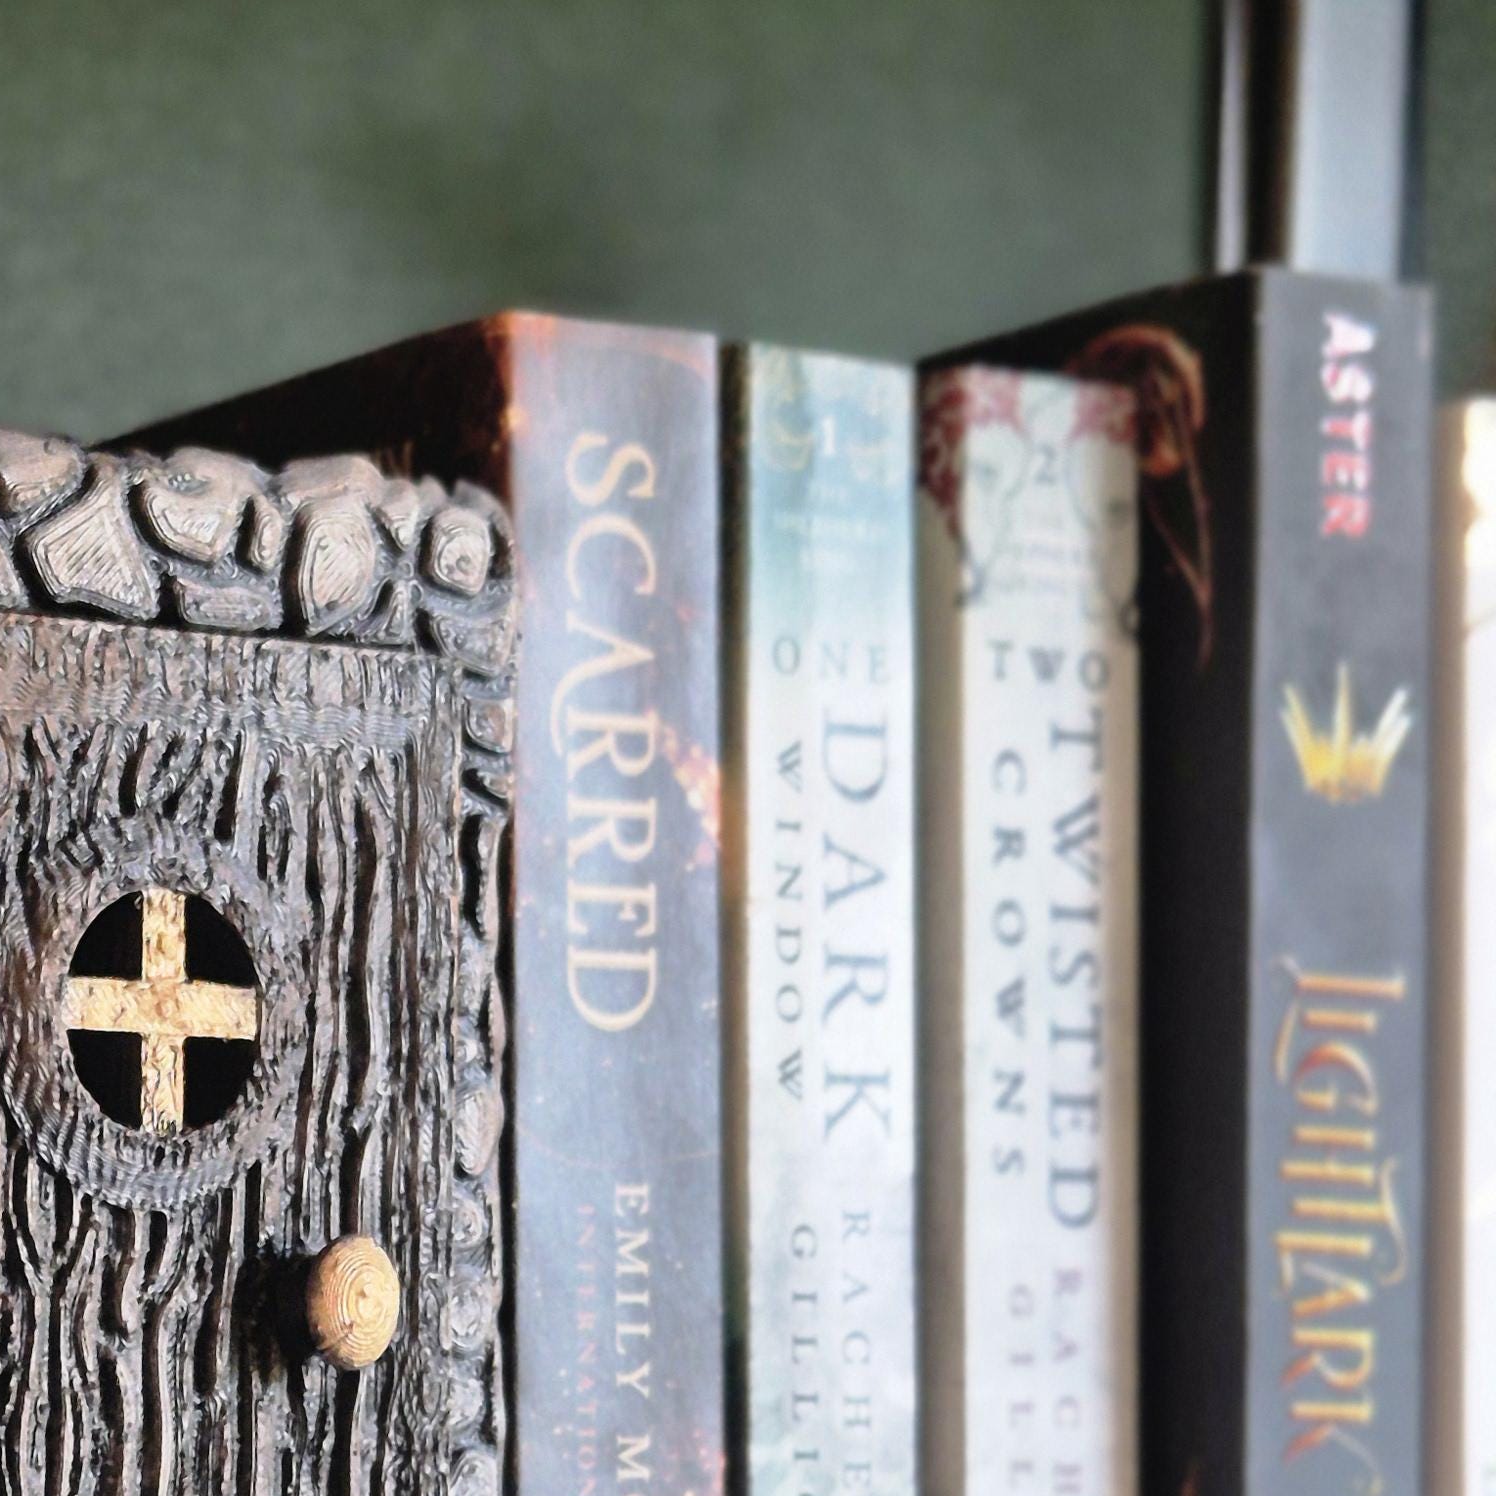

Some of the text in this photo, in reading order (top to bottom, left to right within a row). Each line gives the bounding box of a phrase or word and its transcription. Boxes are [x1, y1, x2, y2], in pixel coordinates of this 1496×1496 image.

[1321, 312, 1376, 538] ASTER
[549, 433, 657, 1031] SCARRED
[772, 634, 889, 685] ONE
[987, 637, 1111, 692] TWO
[774, 740, 803, 1101] WINDOW
[822, 706, 892, 1143] DARK
[992, 748, 1026, 1175] CROWNS
[1049, 704, 1103, 1228] TWISTED
[615, 1183, 651, 1399] EMILY
